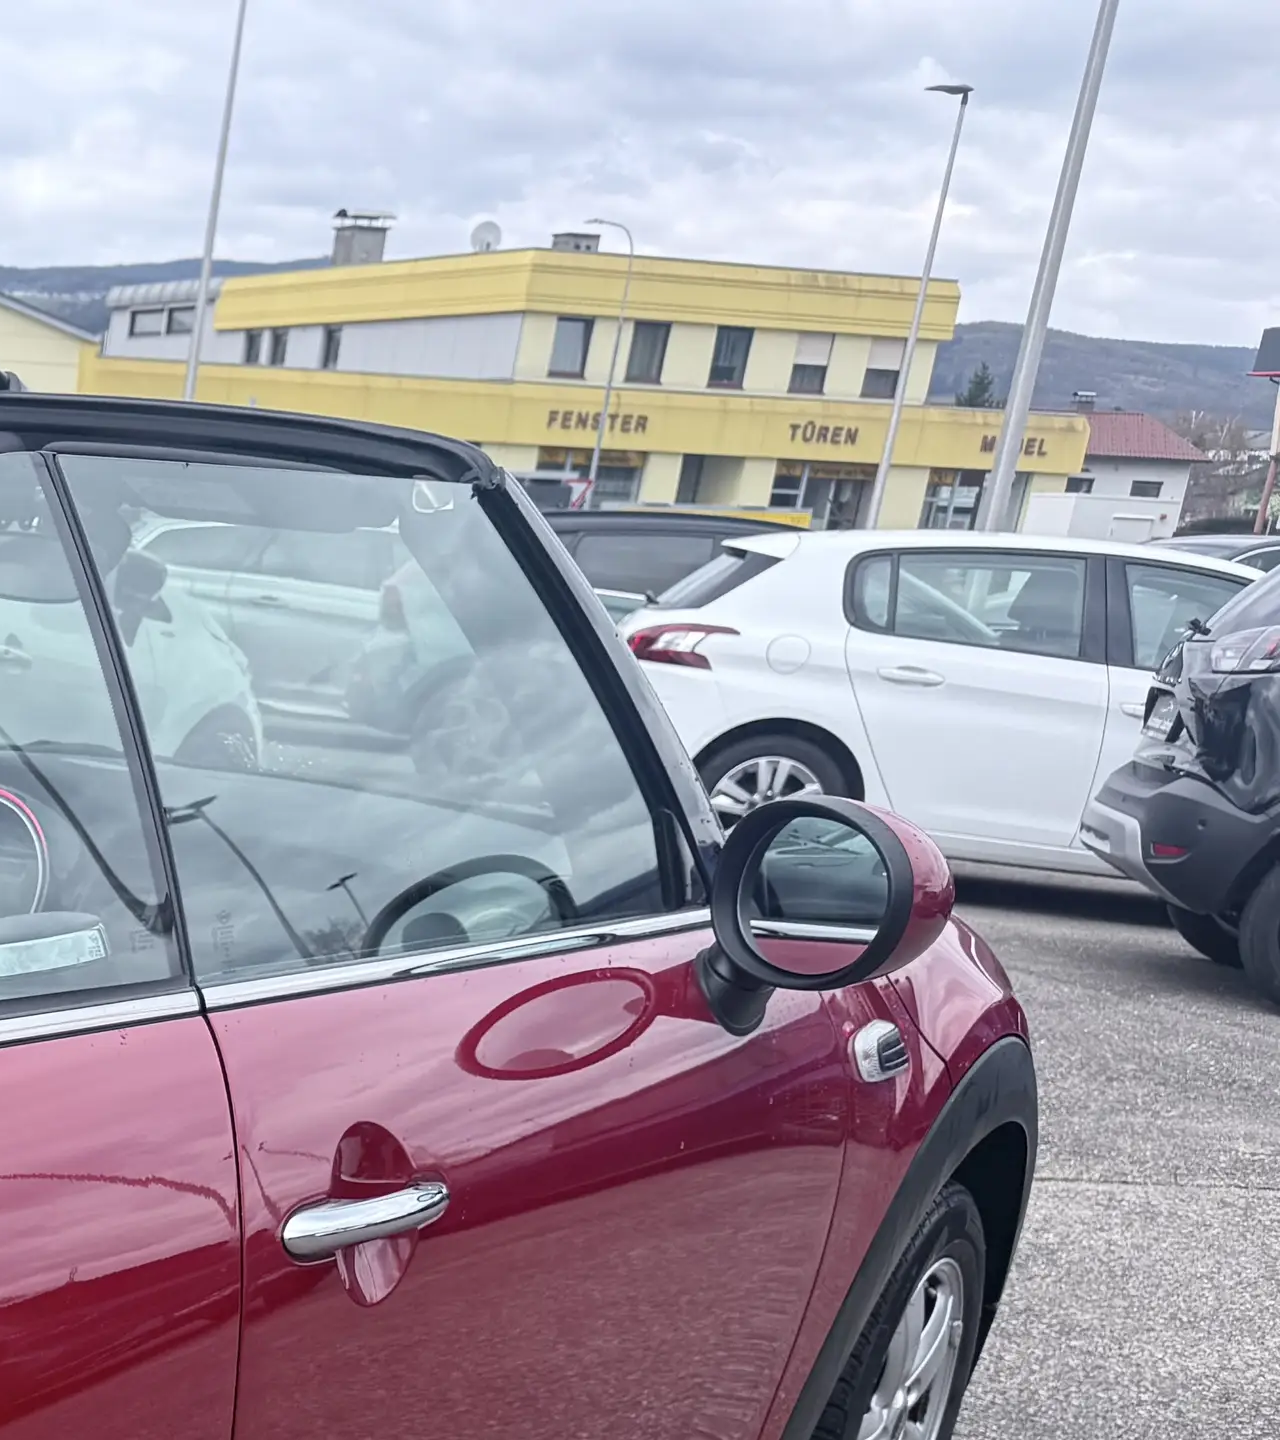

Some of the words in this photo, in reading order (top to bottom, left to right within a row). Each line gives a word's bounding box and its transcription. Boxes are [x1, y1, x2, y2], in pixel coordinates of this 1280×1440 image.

[546, 410, 649, 434] FENSTER
[789, 420, 859, 446] TÜREN
[980, 434, 1048, 457] MEL
